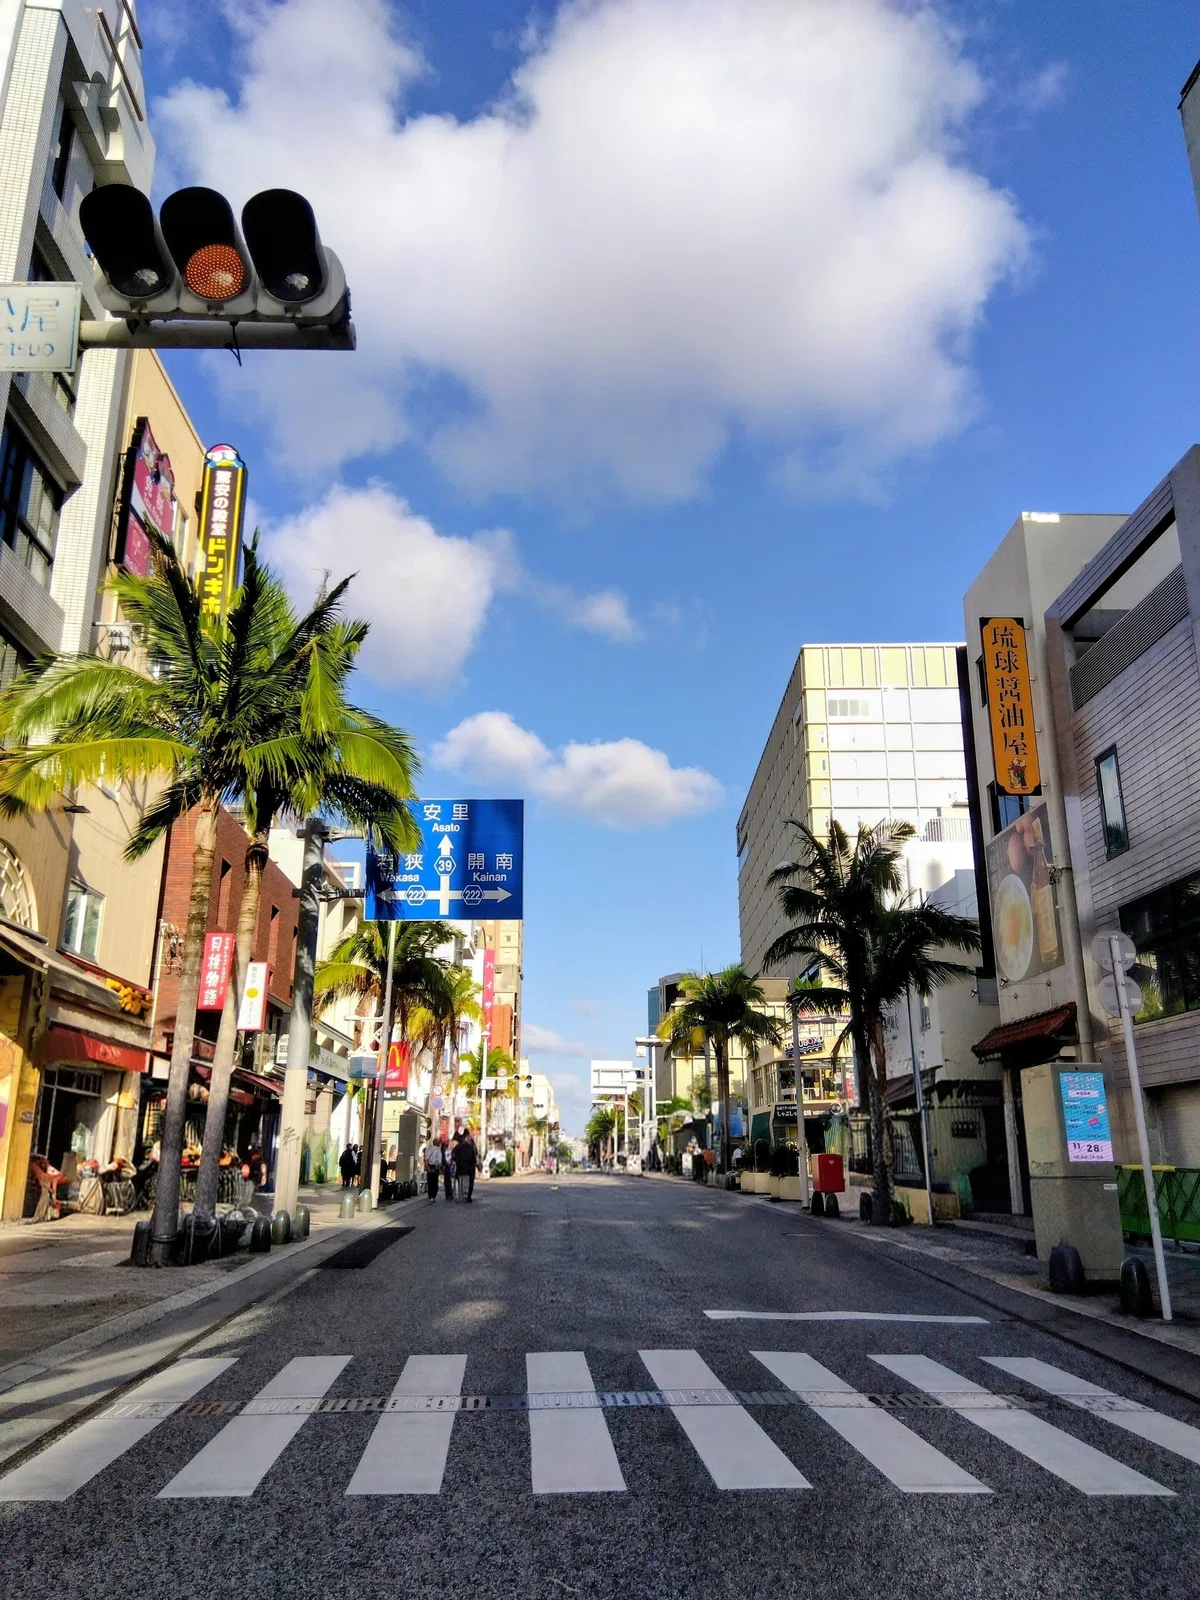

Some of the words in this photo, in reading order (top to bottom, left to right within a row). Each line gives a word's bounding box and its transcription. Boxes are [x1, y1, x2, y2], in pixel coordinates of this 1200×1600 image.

[423, 803, 470, 821] 安里
[431, 823, 461, 833] Asato
[438, 859, 452, 872] 39
[467, 852, 514, 871] 開南
[472, 872, 507, 882] Kainan
[408, 889, 425, 900] 222
[464, 889, 481, 900] 222
